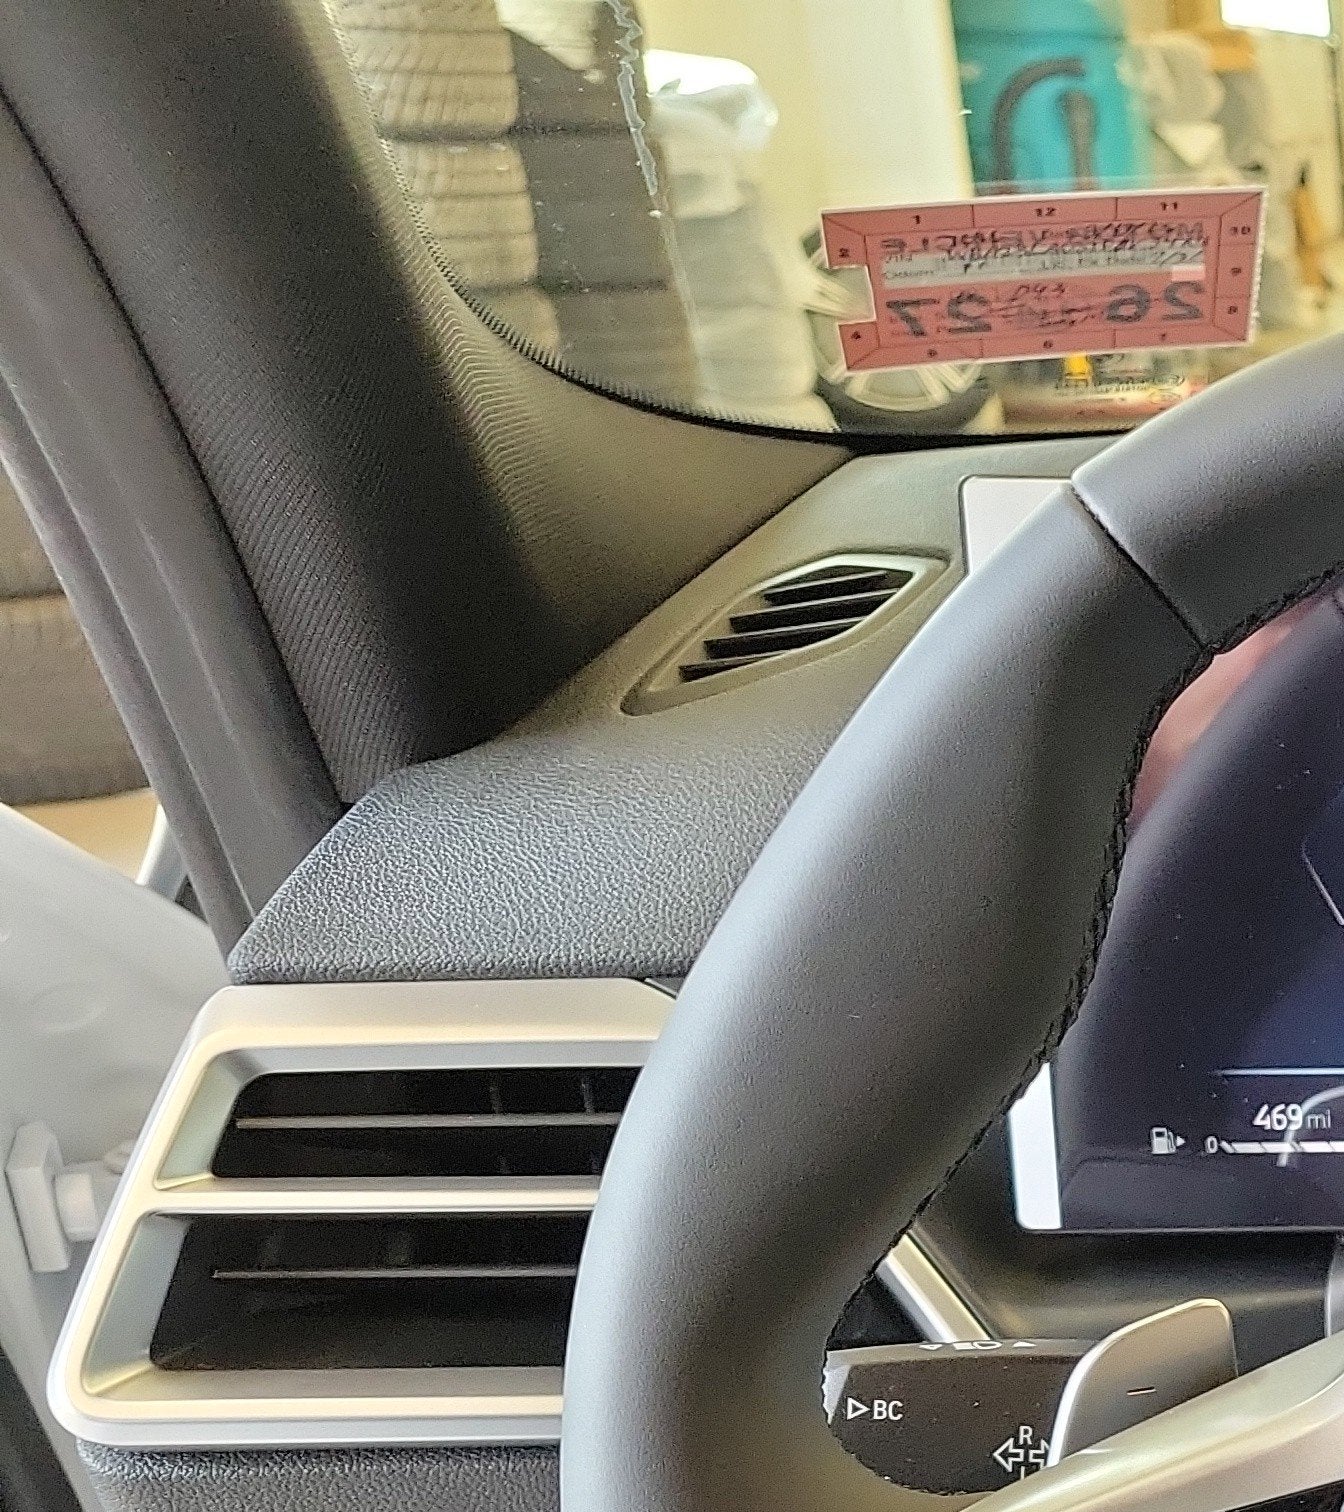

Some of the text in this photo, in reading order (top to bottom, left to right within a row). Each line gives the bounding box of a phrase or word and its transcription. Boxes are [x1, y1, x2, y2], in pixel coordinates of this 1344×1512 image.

[1252, 1103, 1332, 1131] 469 mi
[872, 1399, 904, 1421] BC
[1018, 1426, 1033, 1445] R
